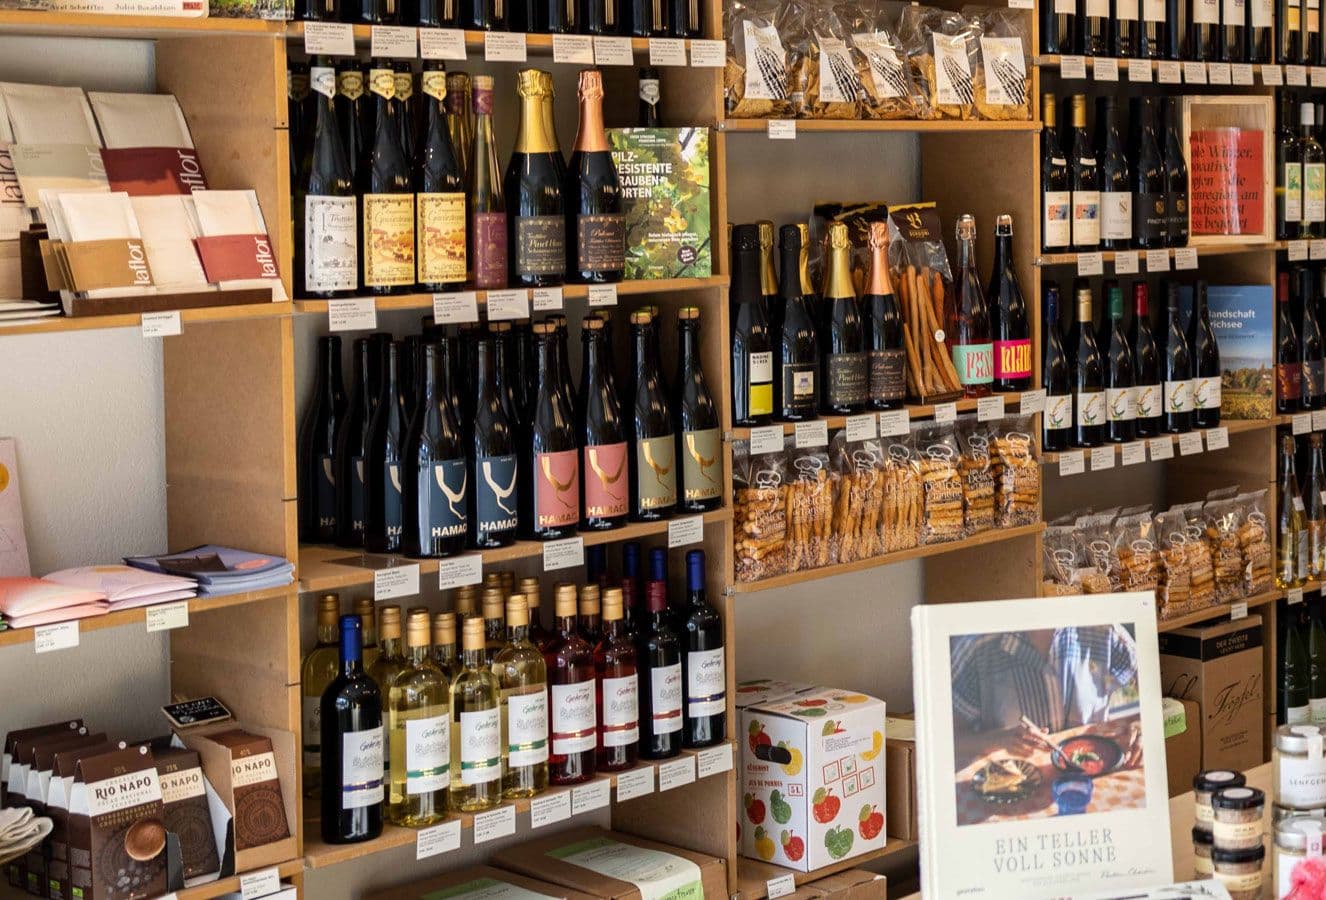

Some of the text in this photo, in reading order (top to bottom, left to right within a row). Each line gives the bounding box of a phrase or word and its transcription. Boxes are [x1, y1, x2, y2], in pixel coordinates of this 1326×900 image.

[616, 163, 672, 174] ESISTENTE
[620, 187, 652, 198] ORTEN
[127, 241, 152, 286] laflor
[254, 236, 278, 280] laflor
[1186, 309, 1256, 320] Wlandschaft
[1209, 320, 1243, 329] richsee
[244, 759, 271, 772] NAPO
[95, 776, 152, 800] RIO NAPO
[171, 774, 199, 788] NAPO
[996, 828, 1114, 856] EIN TELLER
[994, 846, 1117, 873] VOLL SONNE
